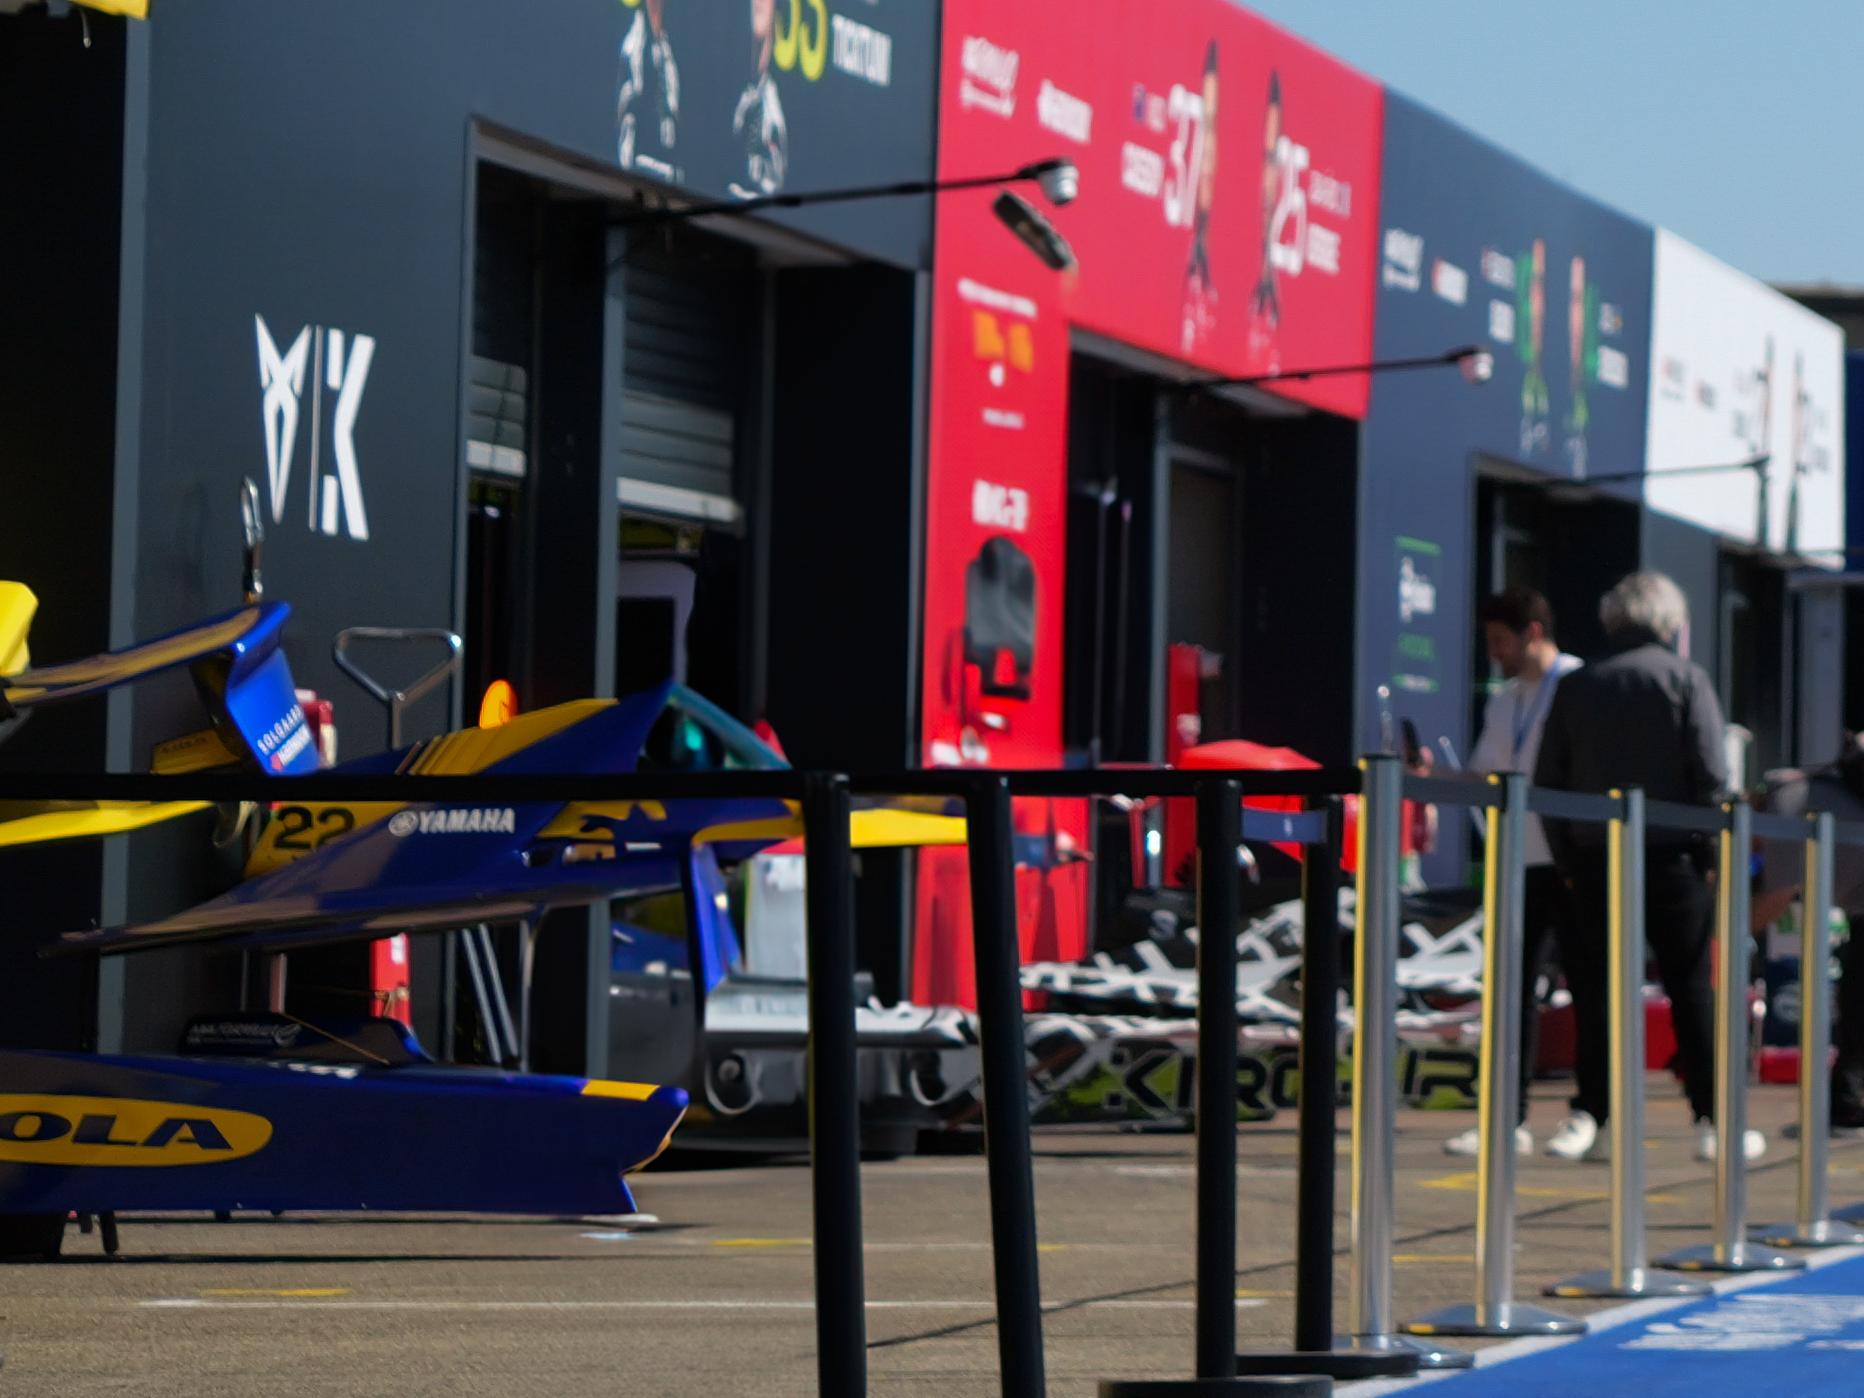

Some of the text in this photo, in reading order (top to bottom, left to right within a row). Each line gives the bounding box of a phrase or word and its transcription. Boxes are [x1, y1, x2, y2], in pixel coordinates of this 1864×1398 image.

[273, 806, 356, 852] 22
[418, 807, 515, 834] YAMAHA
[0, 1110, 235, 1152] OLA
